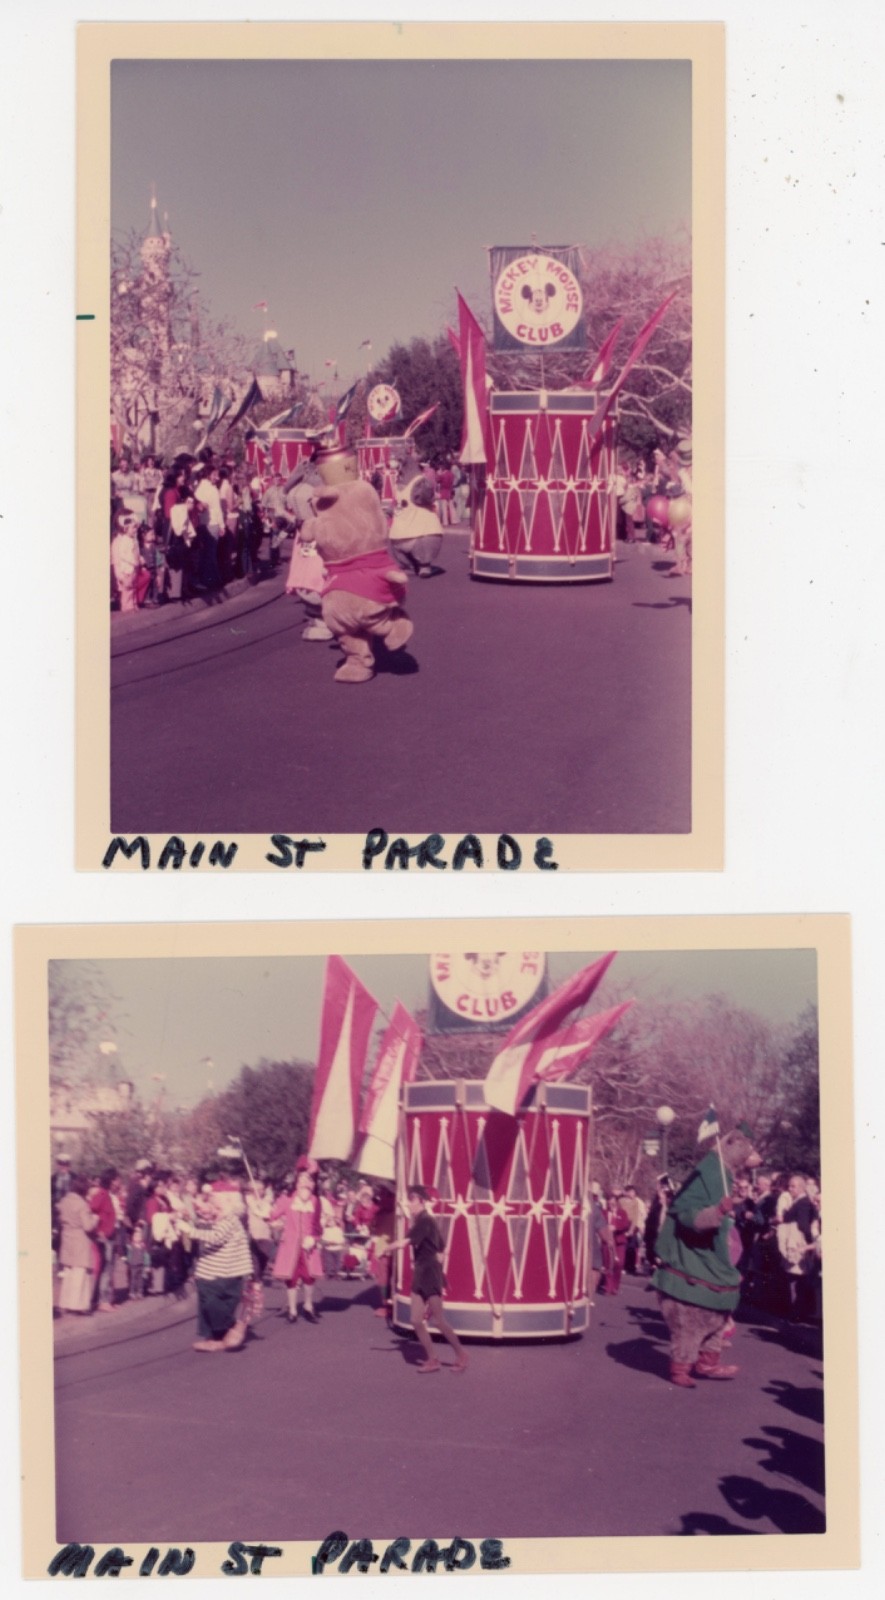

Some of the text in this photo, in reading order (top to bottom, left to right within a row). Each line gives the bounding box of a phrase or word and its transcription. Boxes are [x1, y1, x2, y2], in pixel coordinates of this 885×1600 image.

[546, 261, 579, 313] MOUSE
[516, 322, 564, 342] CLUB
[102, 828, 559, 870] MAIN ST PARADE
[456, 990, 517, 1017] CLUB
[48, 1530, 511, 1577] MAIN ST PARADE
